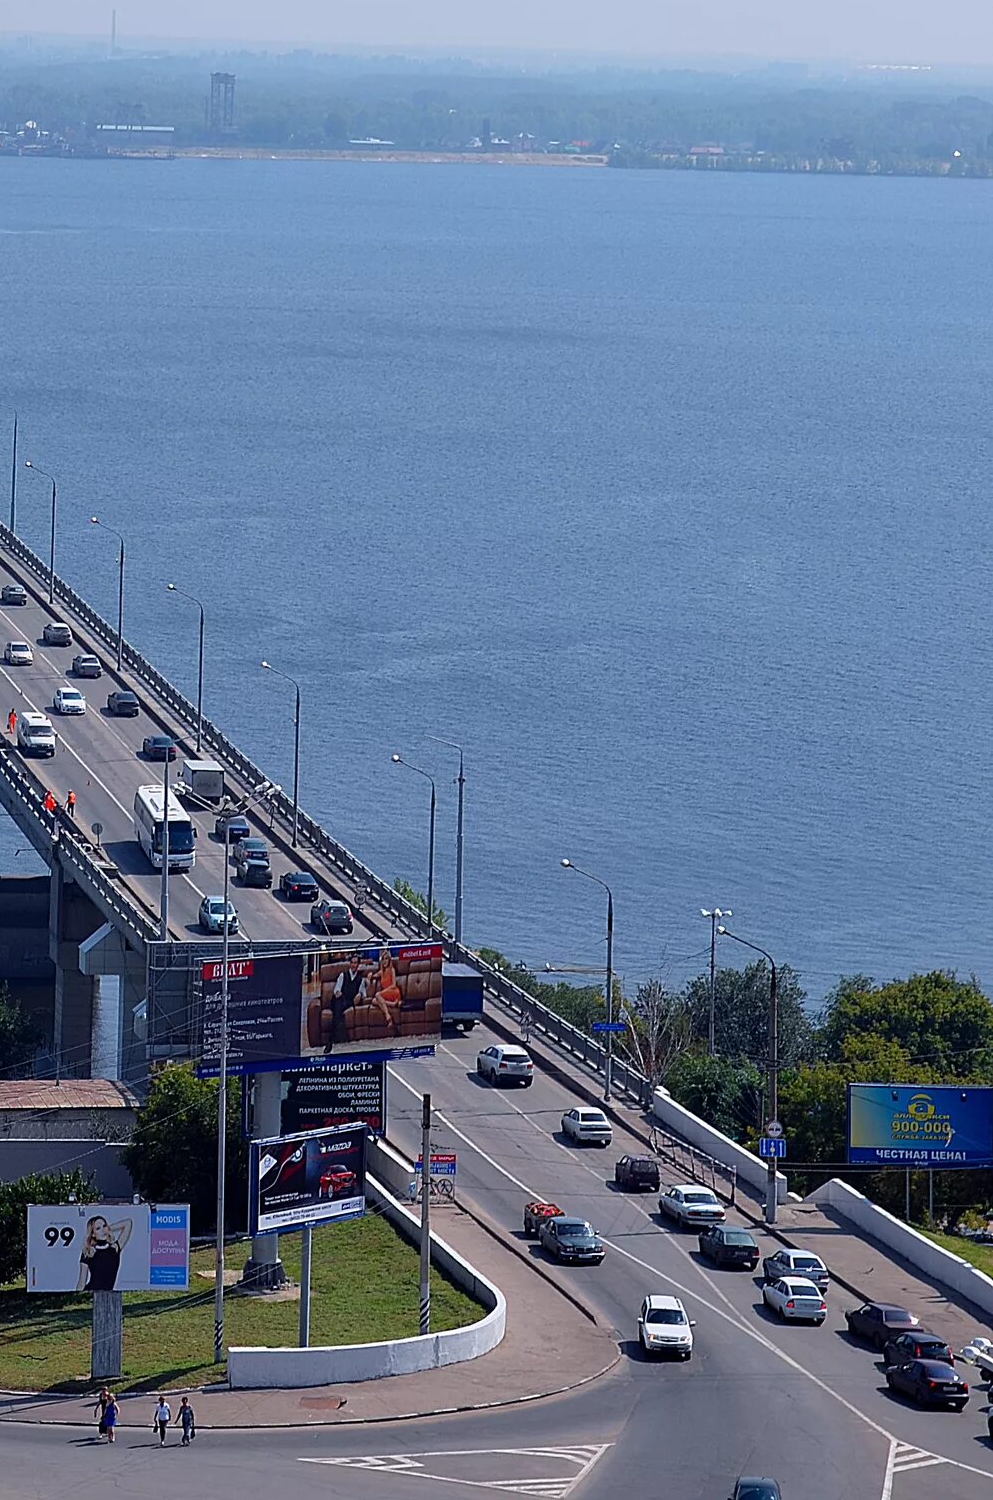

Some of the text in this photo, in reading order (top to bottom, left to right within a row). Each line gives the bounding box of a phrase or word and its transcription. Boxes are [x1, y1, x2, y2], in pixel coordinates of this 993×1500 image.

[337, 1075, 379, 1083] ПОЛИУРЕТАНА
[893, 1121, 951, 1133] 900-000
[876, 1149, 966, 1161] ЧЕСТНАЯ ЦЕНА!
[156, 1215, 181, 1224] MODIS
[44, 1227, 75, 1247] 99
[152, 1247, 185, 1255] ДОСТУПНА
